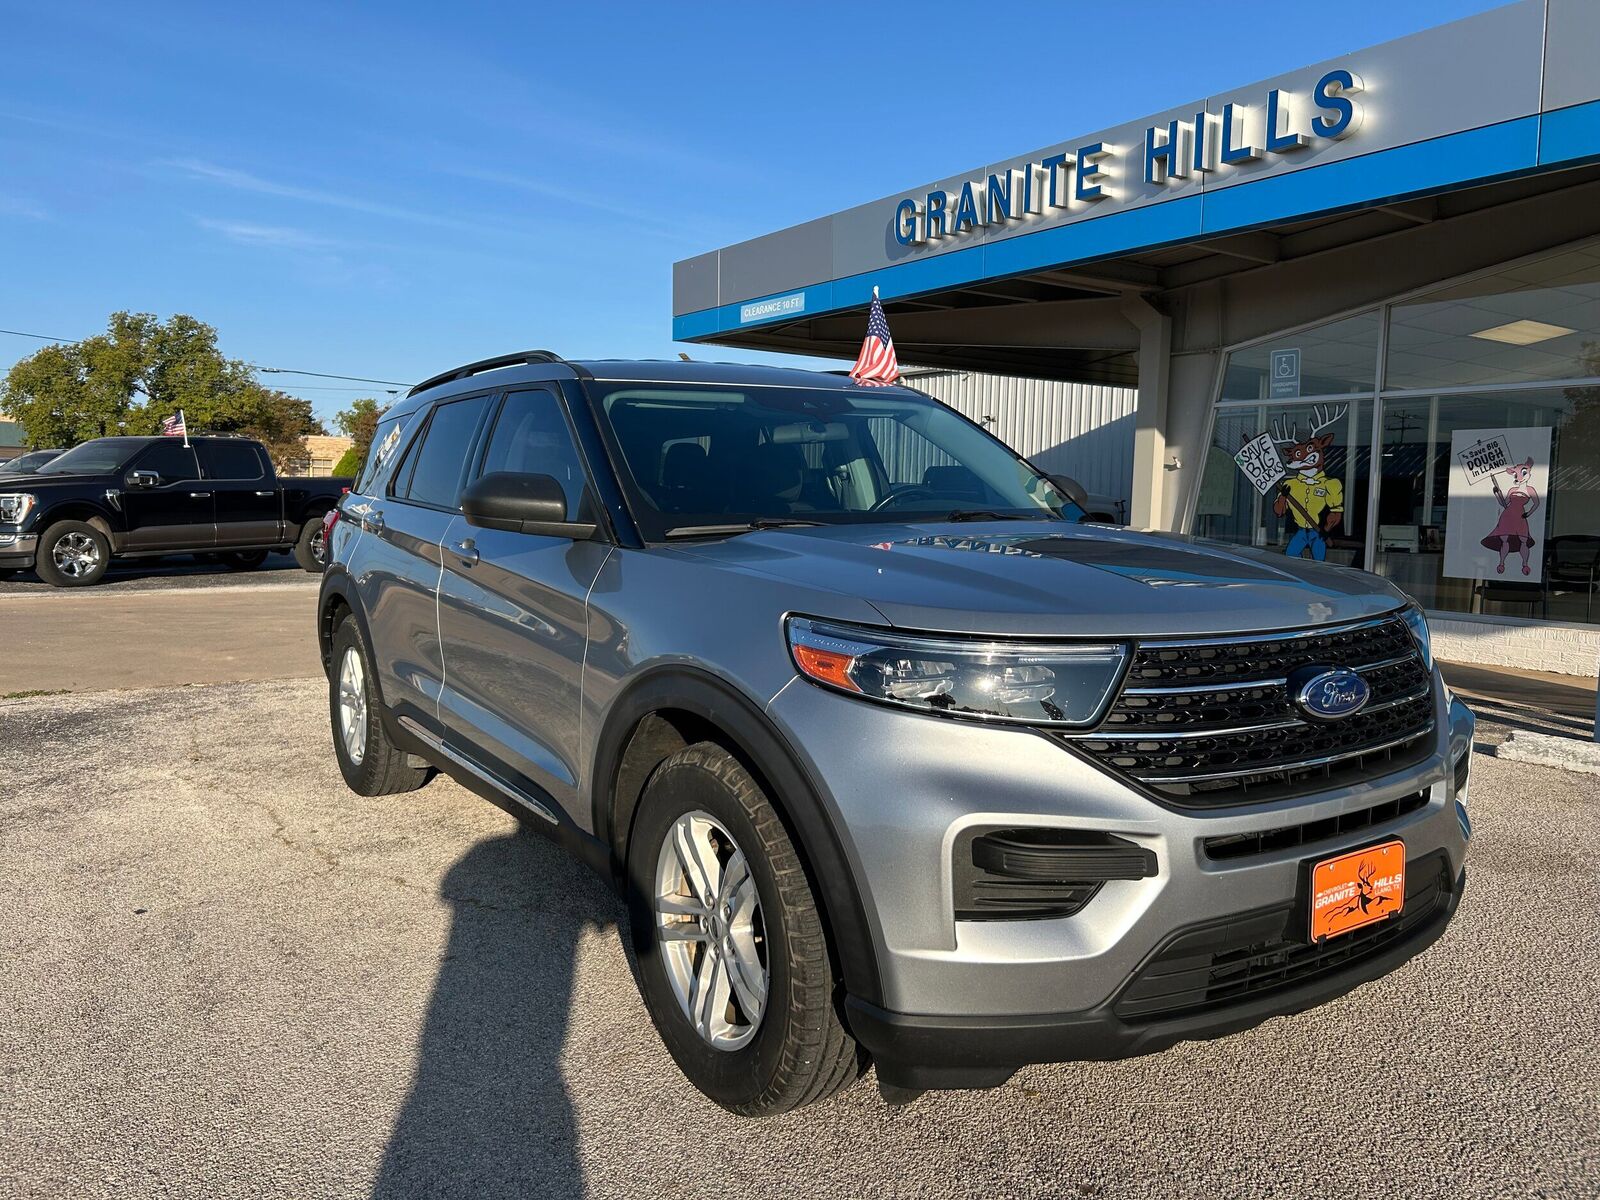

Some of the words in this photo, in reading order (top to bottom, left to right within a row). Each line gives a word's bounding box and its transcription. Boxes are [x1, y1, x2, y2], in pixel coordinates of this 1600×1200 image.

[894, 142, 1108, 246] GRANITE
[1144, 69, 1358, 184] HILLS
[744, 301, 781, 317] CLEARANCE
[782, 300, 790, 310] 10
[791, 297, 800, 308] FT
[1241, 435, 1271, 463] SAVE
[1466, 447, 1504, 471] DOUGH
[1469, 448, 1486, 458] Save
[1486, 440, 1499, 451] BIG
[1246, 450, 1275, 479] BIG
[1255, 461, 1284, 491] BUCKS
[1480, 457, 1508, 474] LLANO!
[1321, 681, 1357, 708] Ford
[1315, 886, 1357, 909] GRANITE
[1373, 873, 1403, 890] HILLS
